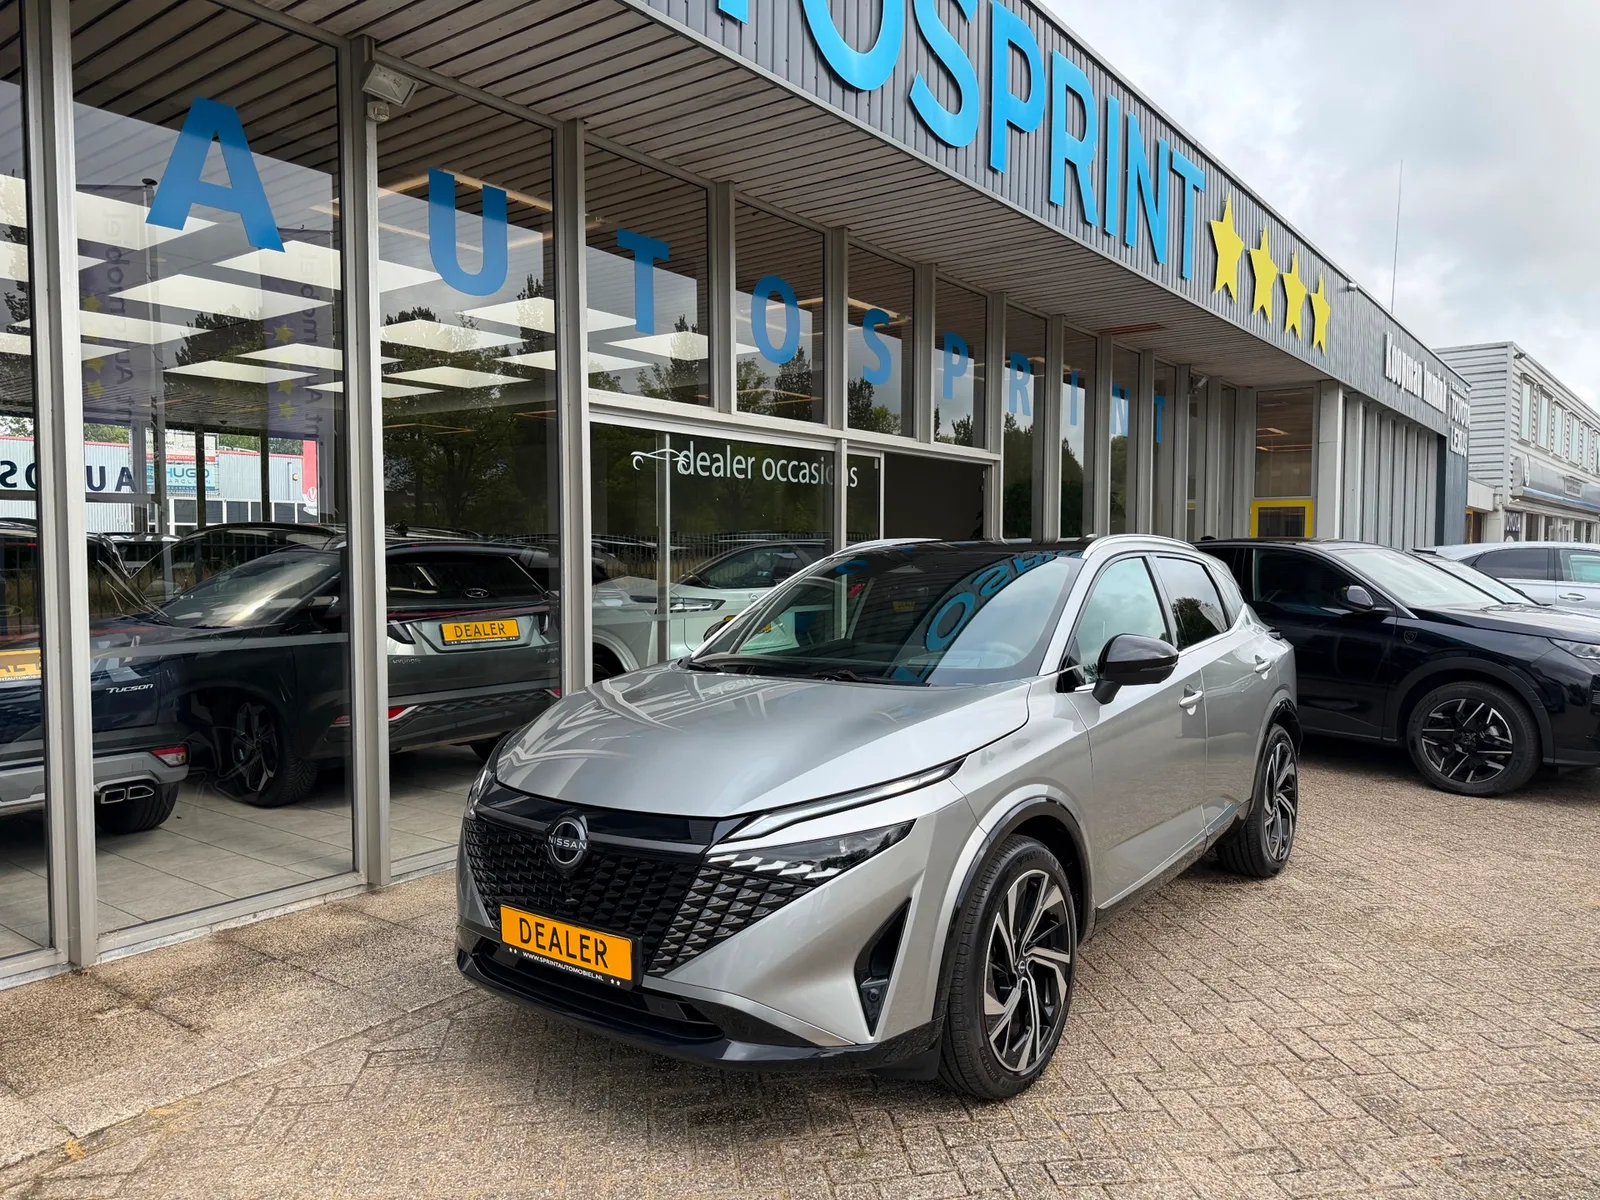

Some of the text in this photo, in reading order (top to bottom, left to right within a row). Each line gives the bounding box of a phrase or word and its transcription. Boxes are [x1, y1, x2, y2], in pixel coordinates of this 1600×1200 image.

[719, 0, 1205, 280] OSPRINT
[1385, 331, 1423, 398] Koopman
[1450, 393, 1471, 429] TOYOTA
[678, 440, 755, 479] dealer
[1450, 425, 1468, 458] LEXUS
[454, 623, 507, 638] DEALER
[548, 835, 587, 850] NISSAN
[519, 917, 609, 969] DEALER
